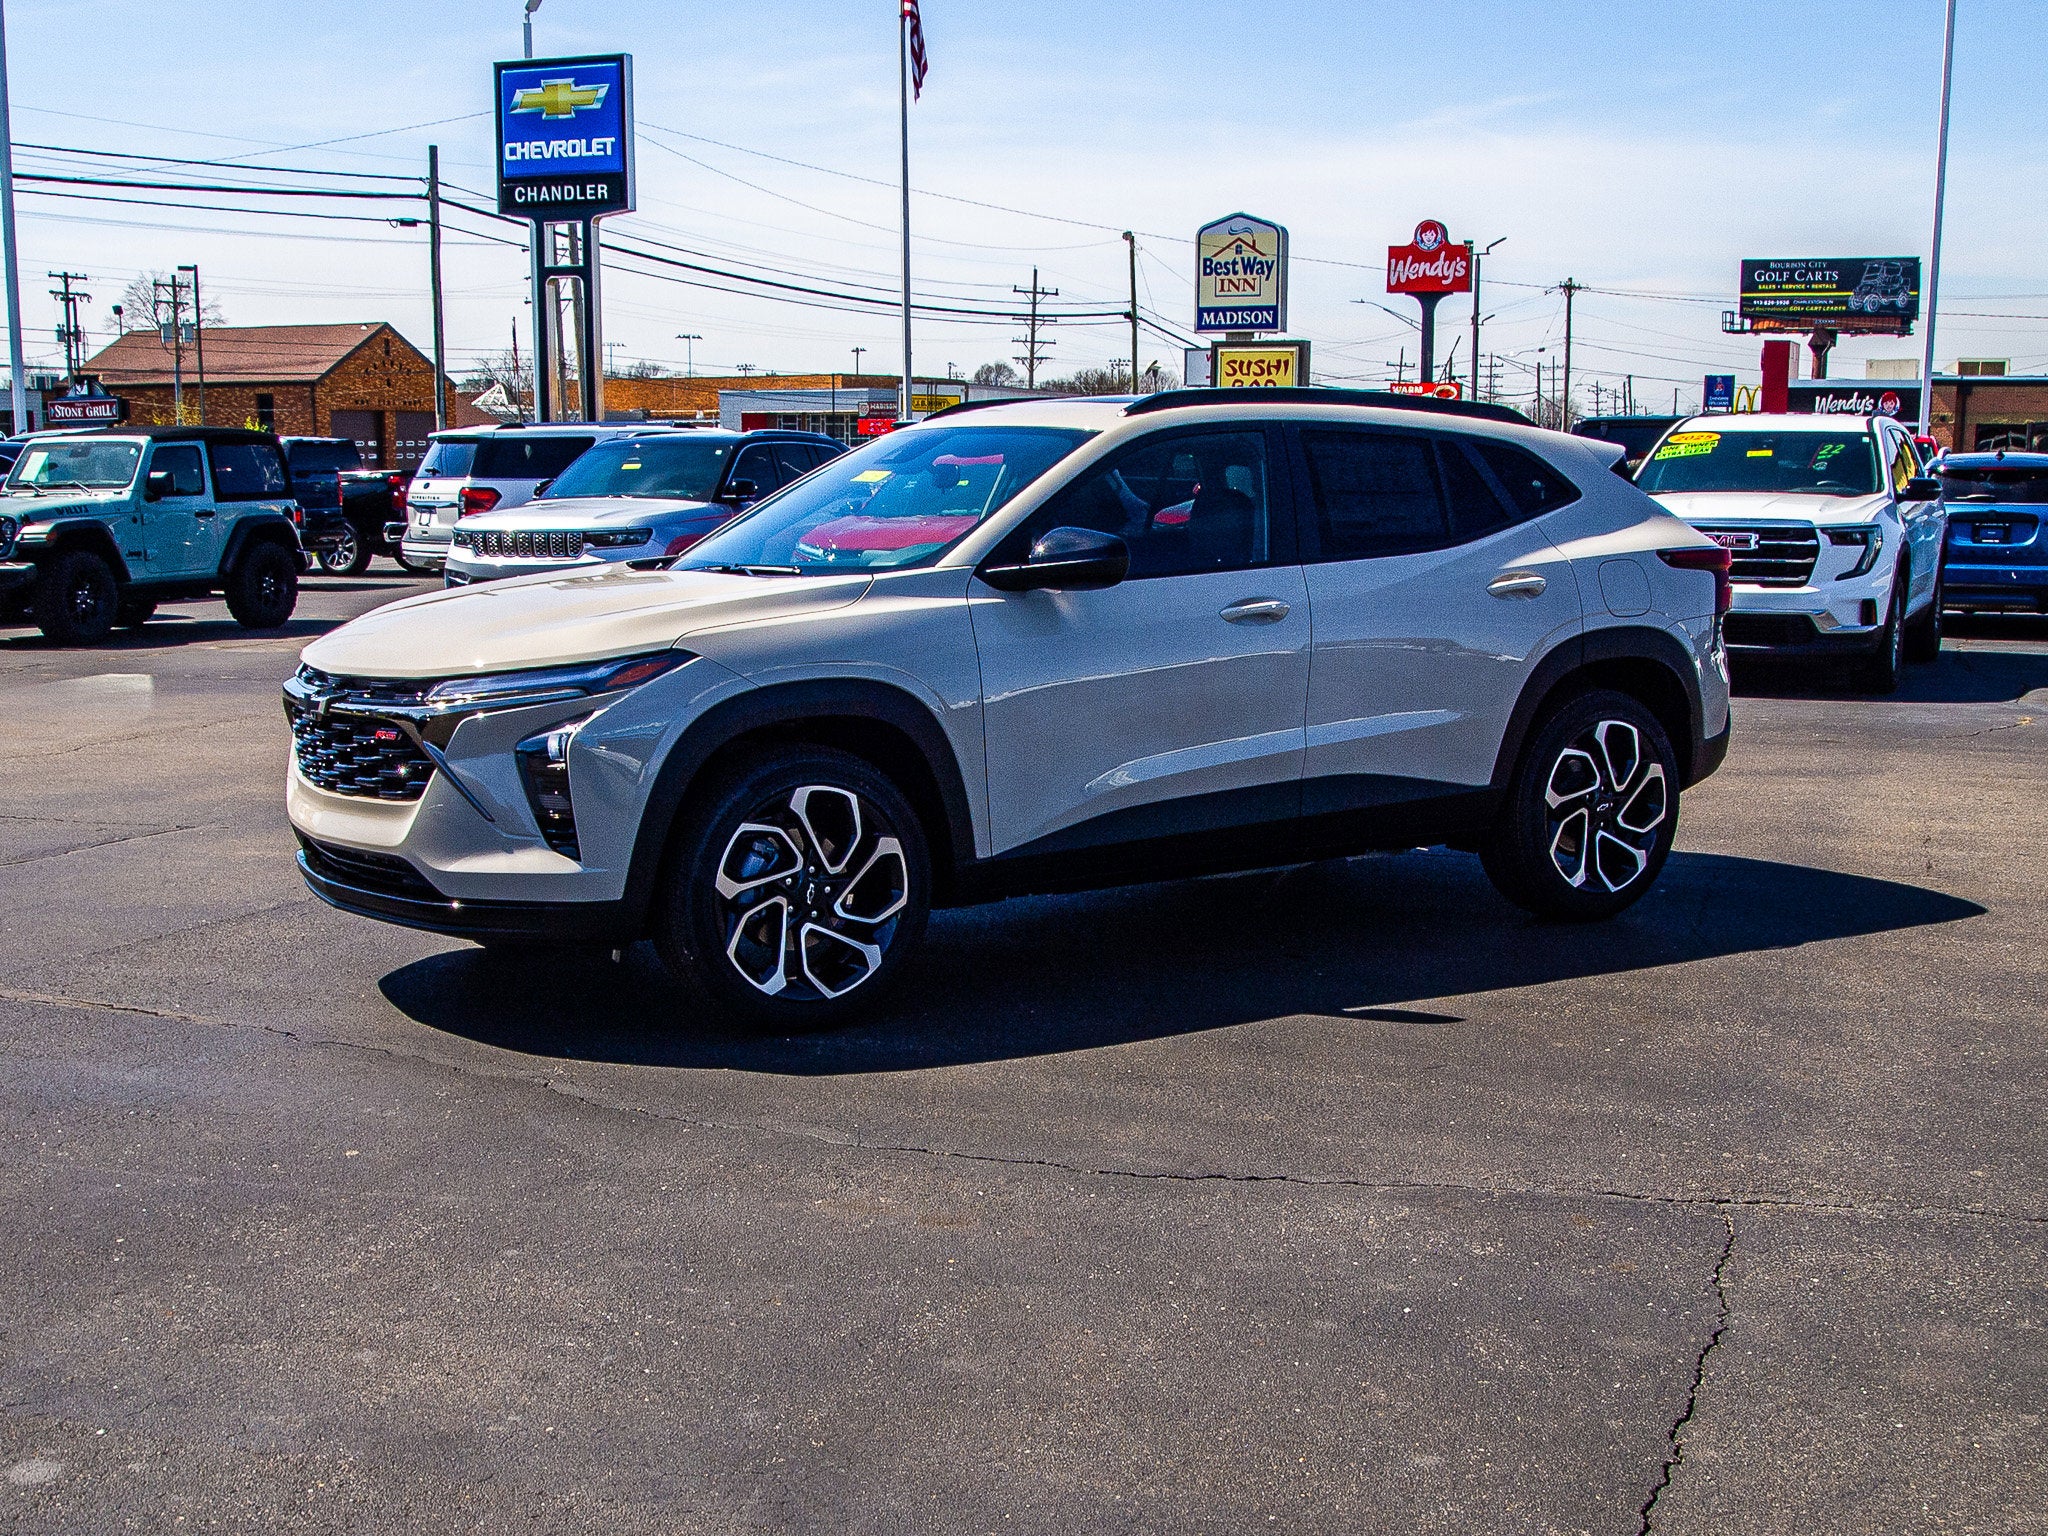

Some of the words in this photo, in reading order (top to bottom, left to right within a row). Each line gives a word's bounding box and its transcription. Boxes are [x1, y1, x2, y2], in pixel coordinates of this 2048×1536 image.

[505, 137, 616, 161] CHEVROLET
[514, 184, 608, 203] CHANDLER
[1203, 257, 1239, 277] Best
[1240, 256, 1275, 281] Way
[1389, 251, 1467, 286] Wendy's
[1769, 261, 1806, 269] BOURBON
[1808, 260, 1828, 268] CITY
[1754, 270, 1790, 282] GOLF
[1794, 269, 1839, 281] CARTS
[1219, 278, 1257, 292] INN
[1202, 311, 1274, 325] MADISON
[1225, 359, 1290, 377] SUSHI
[1392, 385, 1424, 394] WARM
[1815, 392, 1875, 415] Wendy's
[55, 405, 83, 418] STONE
[86, 404, 112, 417] GRILL
[1819, 444, 1846, 455] 22
[55, 504, 90, 516] WILLYS
[1705, 534, 1751, 548] MC
